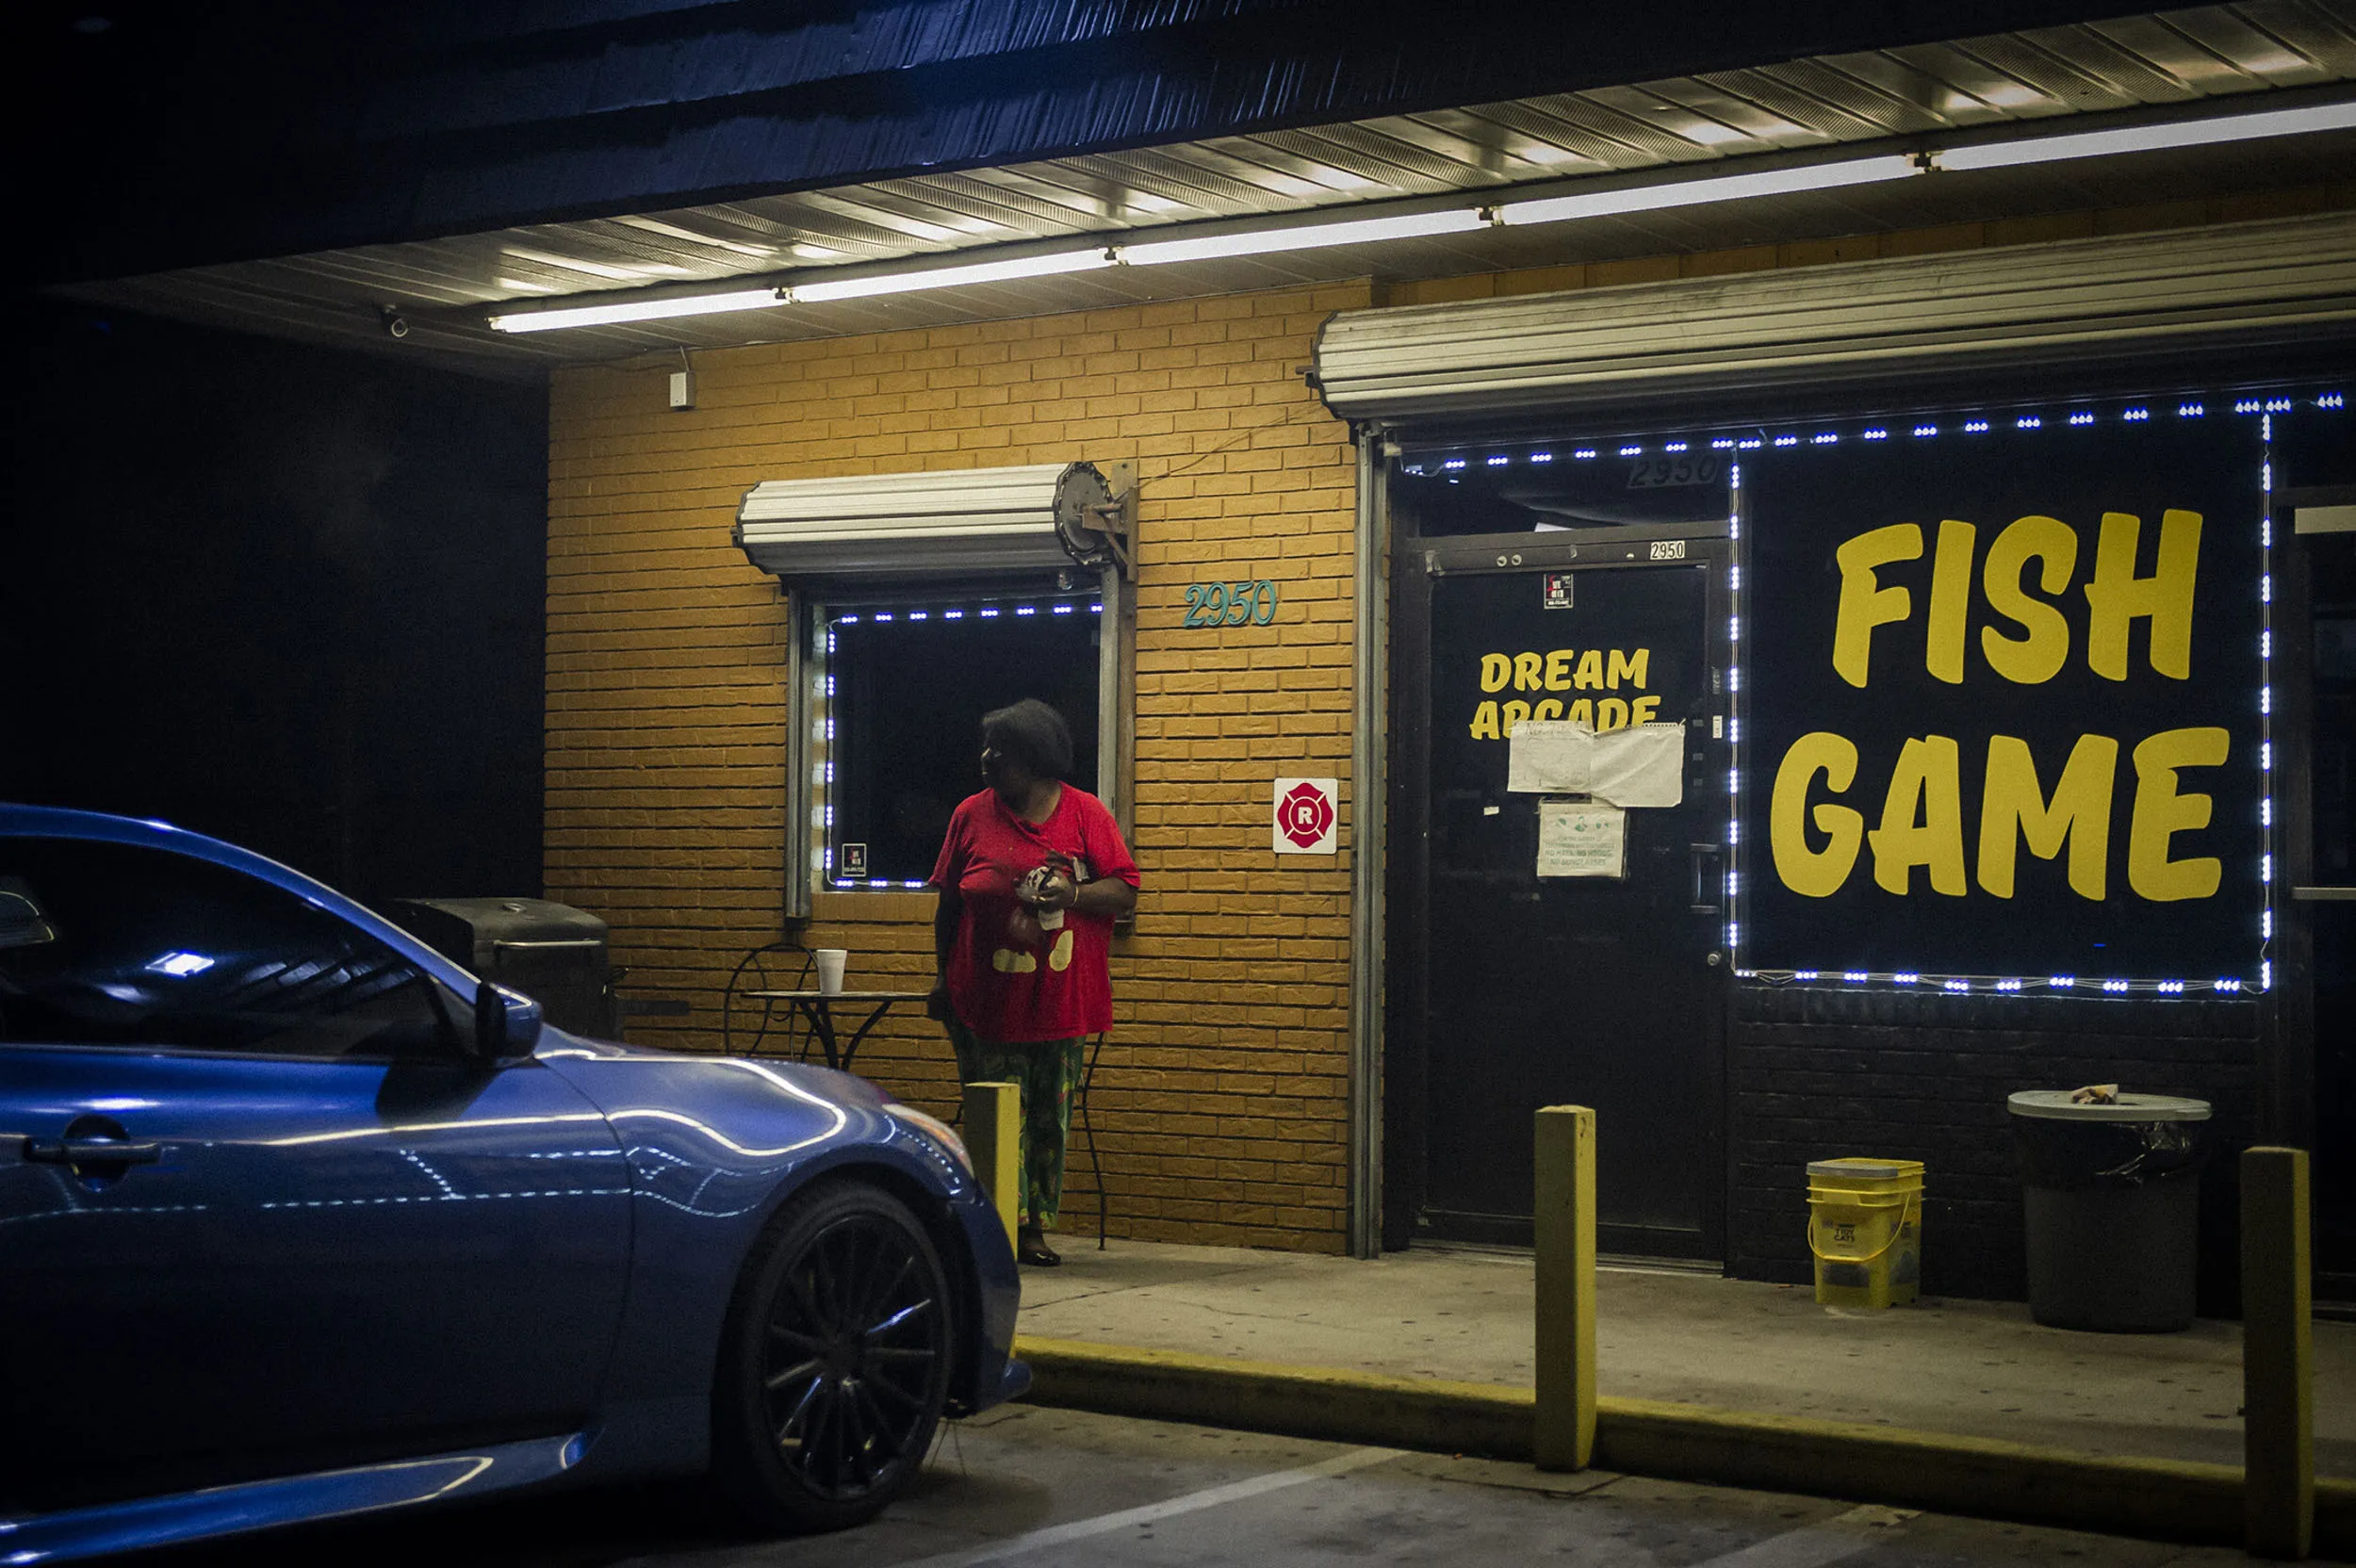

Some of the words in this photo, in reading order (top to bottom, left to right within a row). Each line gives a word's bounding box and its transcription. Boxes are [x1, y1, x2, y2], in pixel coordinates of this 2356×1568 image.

[1629, 454, 1717, 486] 2950
[1651, 542, 1683, 559] 2950
[1183, 580, 1277, 629] 2950
[1832, 508, 2203, 689] FISH
[1481, 648, 1649, 693] DREAM
[1298, 807, 1314, 825] R
[1770, 727, 2231, 902] GAME
